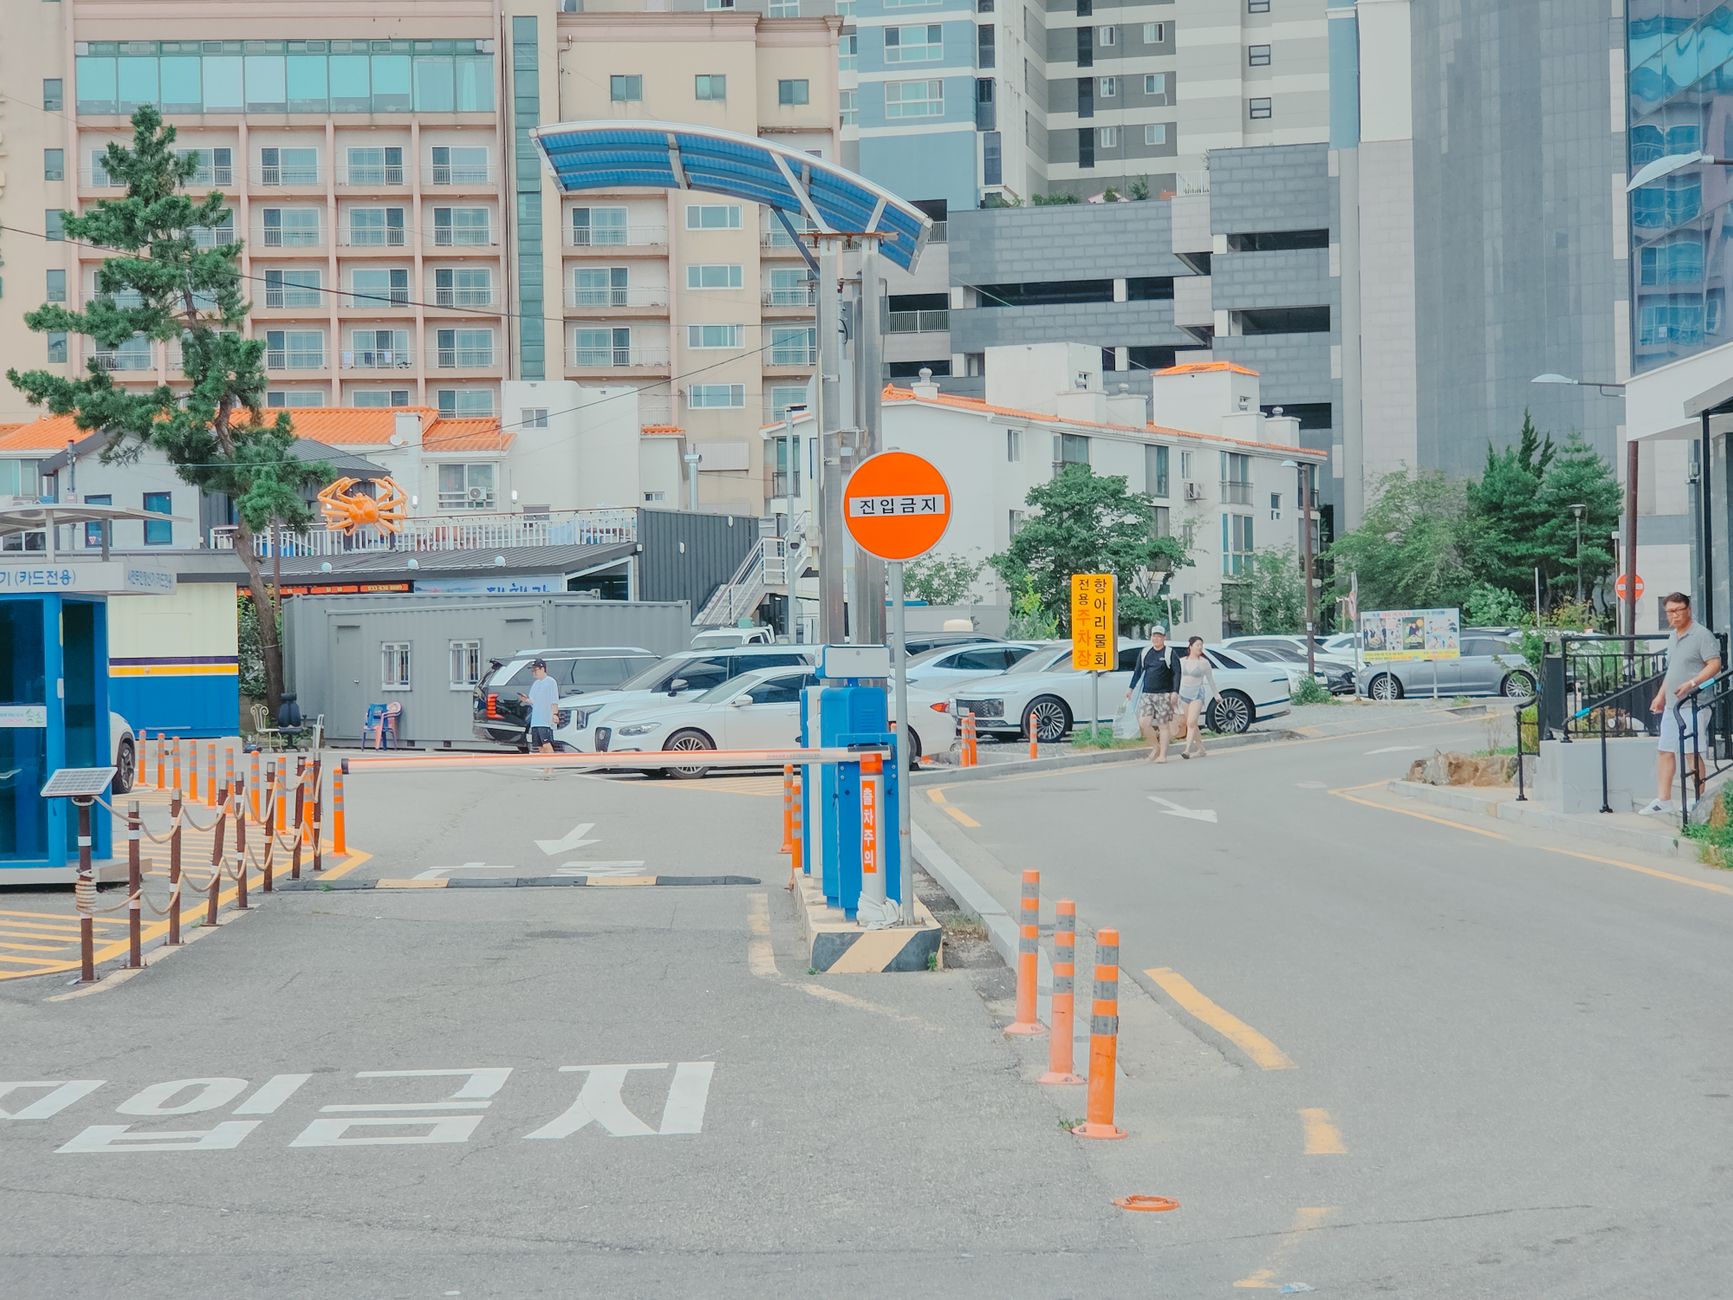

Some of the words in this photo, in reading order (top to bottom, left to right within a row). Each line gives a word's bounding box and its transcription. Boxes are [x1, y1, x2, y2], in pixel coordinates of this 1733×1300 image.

[860, 496, 936, 515] 진입금지
[1093, 578, 1107, 667] 항아리물회
[863, 787, 874, 868] 출차주의
